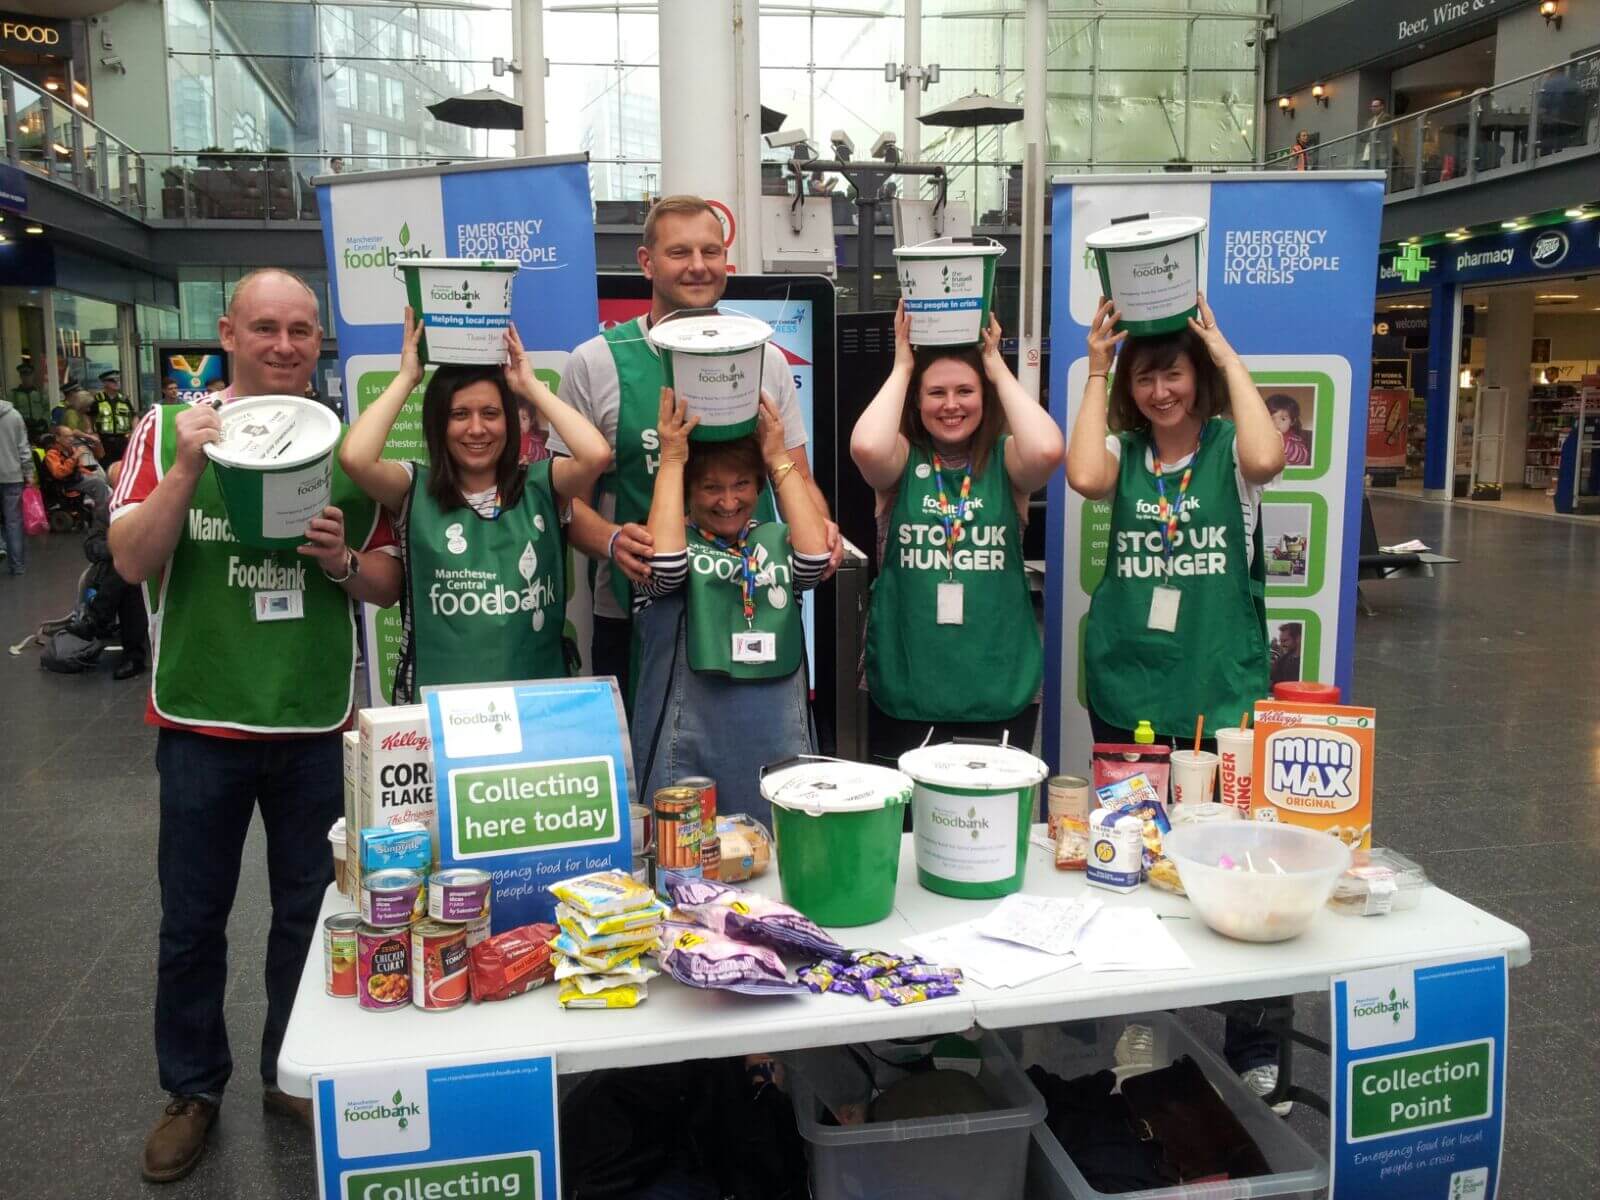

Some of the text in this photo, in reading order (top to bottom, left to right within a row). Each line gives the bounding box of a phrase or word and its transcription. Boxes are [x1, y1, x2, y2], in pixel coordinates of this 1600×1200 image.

[1398, 15, 1429, 40] Beer,
[1433, 1, 1470, 26] Wine
[3, 23, 60, 46] FOOD
[457, 219, 543, 239] EMERGENCY
[1226, 230, 1327, 244] EMERGENCY
[458, 235, 529, 251] FOOD FOR
[1225, 244, 1310, 258] FOOD FOR
[501, 247, 557, 262] PEOPLE
[1225, 257, 1340, 272] LOCAL PEOPLE
[1457, 248, 1514, 271] pharmacy
[1132, 260, 1180, 279] foodbank
[1224, 271, 1294, 285] IN CRISIS
[431, 289, 480, 300] foodbank
[924, 302, 949, 311] people
[951, 300, 958, 308] in
[960, 299, 977, 308] crisis
[431, 315, 463, 326] Helping
[465, 316, 485, 324] local
[1395, 318, 1427, 329] welcome
[698, 371, 745, 383] foodbank
[971, 526, 1007, 547] UK
[1189, 526, 1227, 549] UK
[900, 548, 1005, 571] HUNGER
[1117, 552, 1227, 578] HUNGER
[228, 556, 306, 590] Foodbank
[435, 568, 496, 580] Manchester
[429, 575, 555, 615] foodbank
[447, 580, 487, 590] Central
[449, 710, 512, 726] foodbank
[1259, 710, 1303, 727] Kellogg's
[381, 730, 431, 751] Kellog
[1273, 737, 1352, 766] mini
[380, 762, 432, 788] COR
[1223, 752, 1236, 806] URGER
[1272, 762, 1352, 797] MAX
[381, 786, 433, 808] FLAKE
[468, 773, 600, 805] Collecting
[1286, 796, 1336, 810] ORIGINAL
[465, 805, 607, 840] here today
[932, 811, 989, 829] foodbank
[536, 862, 560, 875] food
[566, 859, 581, 871] for
[585, 854, 612, 869] local
[496, 883, 533, 902] people
[375, 950, 405, 963] CHICKEN
[377, 960, 404, 973] CURRY
[1353, 998, 1409, 1018] foodbank
[1361, 1060, 1480, 1096] Collection
[344, 1102, 420, 1122] foodbank
[1390, 1093, 1452, 1123] Point
[1354, 1129, 1483, 1165] Emergency food for local
[1380, 1153, 1457, 1180] people in crisis
[363, 1171, 520, 1200] Collecting
